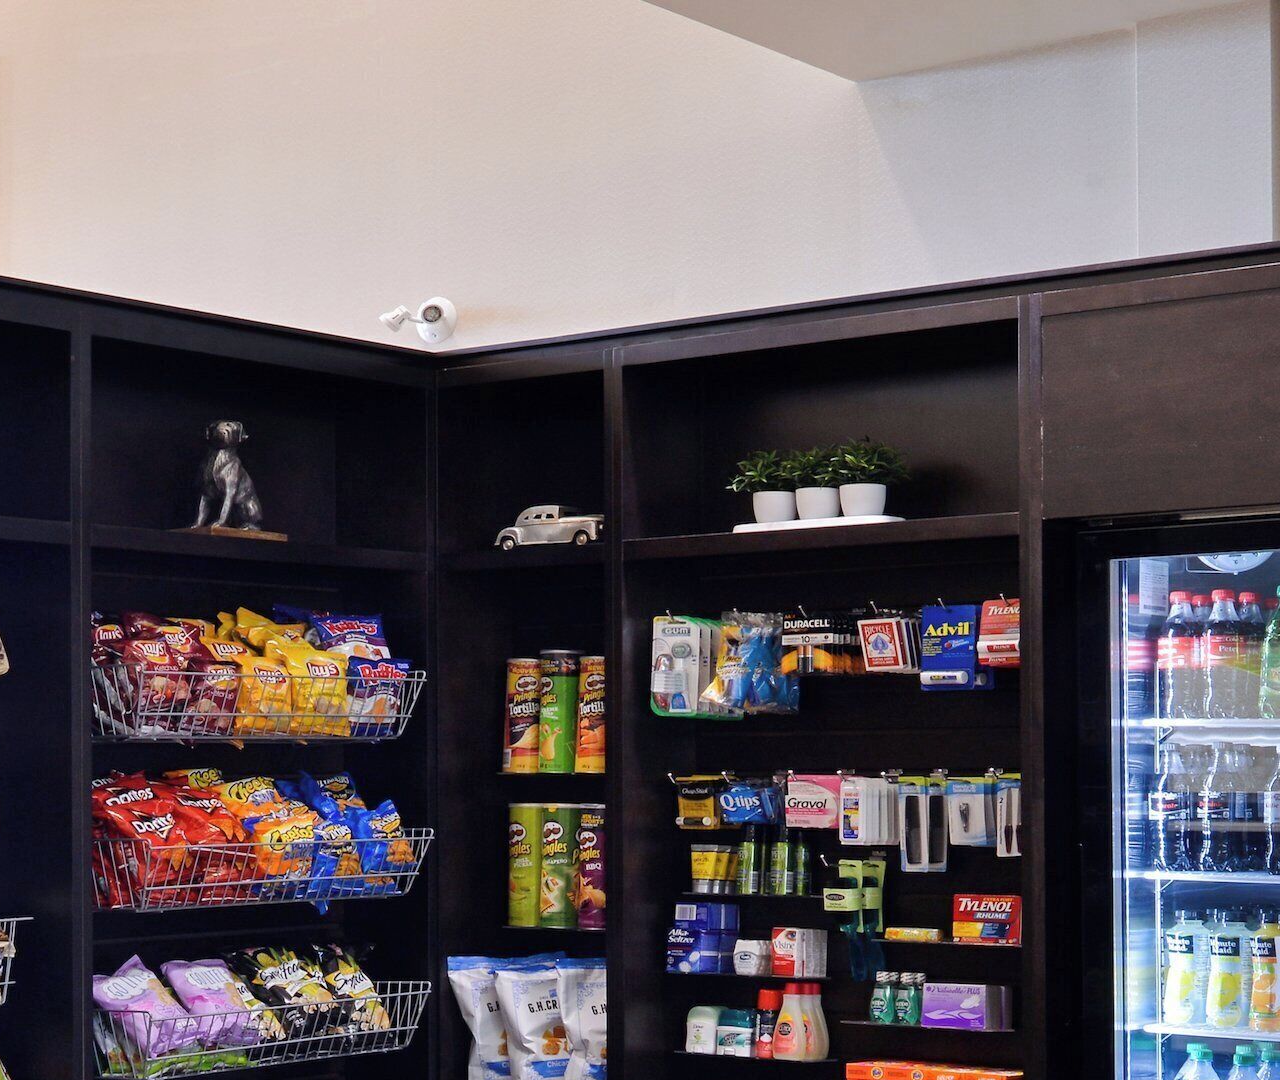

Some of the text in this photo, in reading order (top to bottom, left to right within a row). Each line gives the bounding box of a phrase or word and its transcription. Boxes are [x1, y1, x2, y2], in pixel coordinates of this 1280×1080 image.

[784, 619, 830, 630] DURACELL
[924, 622, 970, 636] Advil
[864, 625, 890, 636] BICYCLE
[801, 635, 810, 643] 10
[787, 798, 827, 809] Gravol
[958, 898, 1012, 912] TYLENOL
[774, 940, 795, 950] Visine
